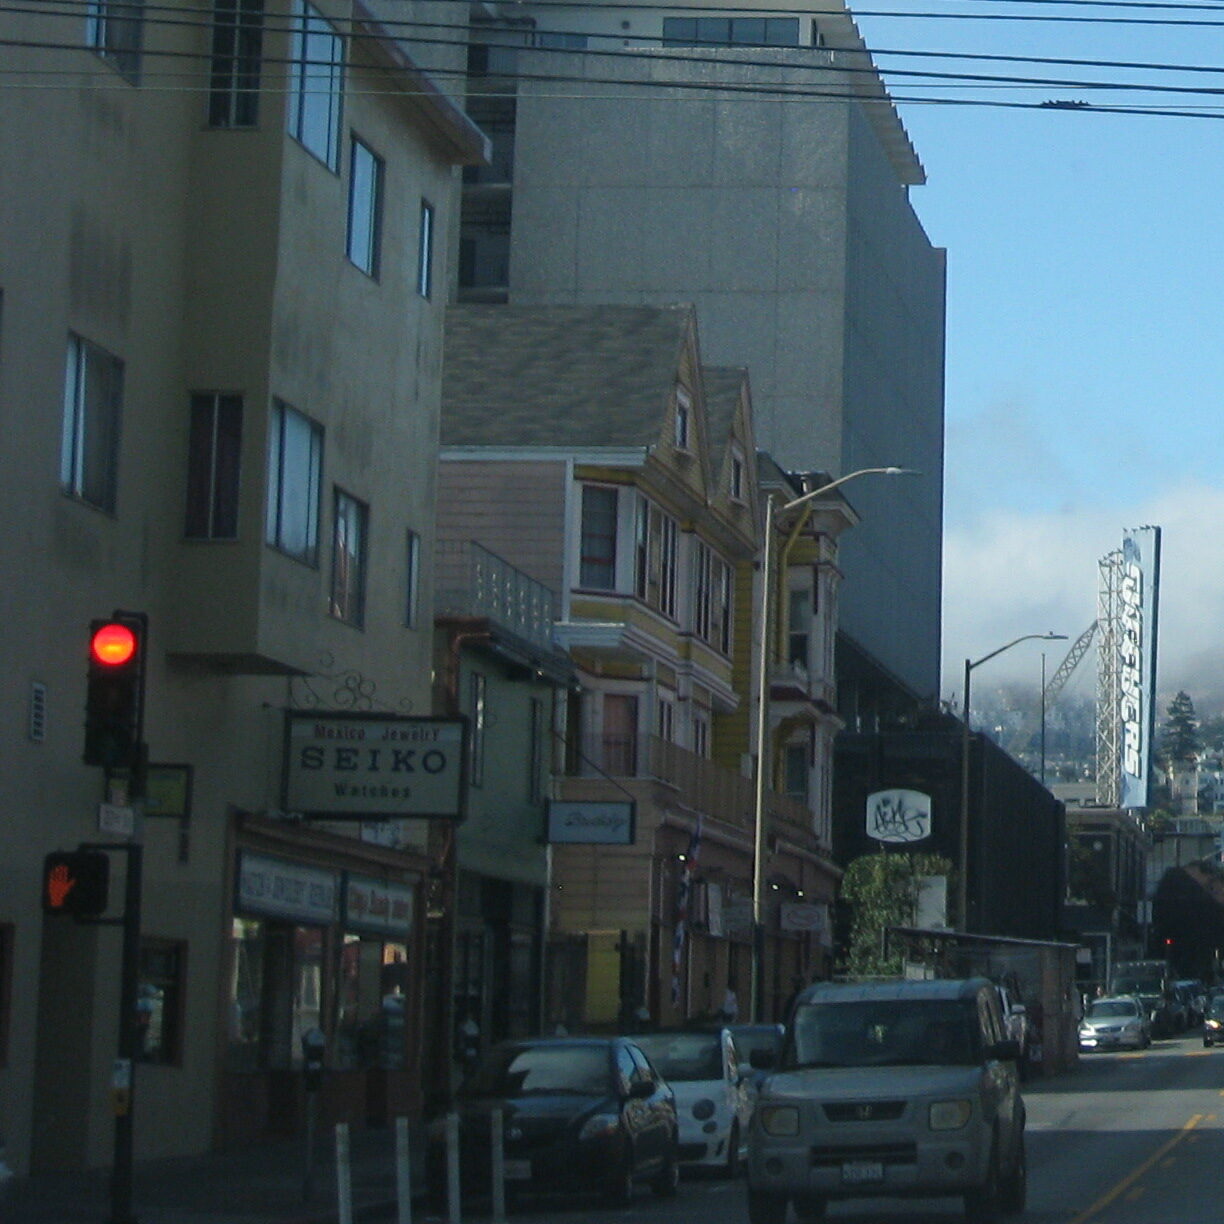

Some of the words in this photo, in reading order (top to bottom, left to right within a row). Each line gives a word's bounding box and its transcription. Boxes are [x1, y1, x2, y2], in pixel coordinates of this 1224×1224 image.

[314, 725, 366, 740] Mexico
[301, 746, 447, 774] SEIKO
[335, 782, 411, 798] Watches
